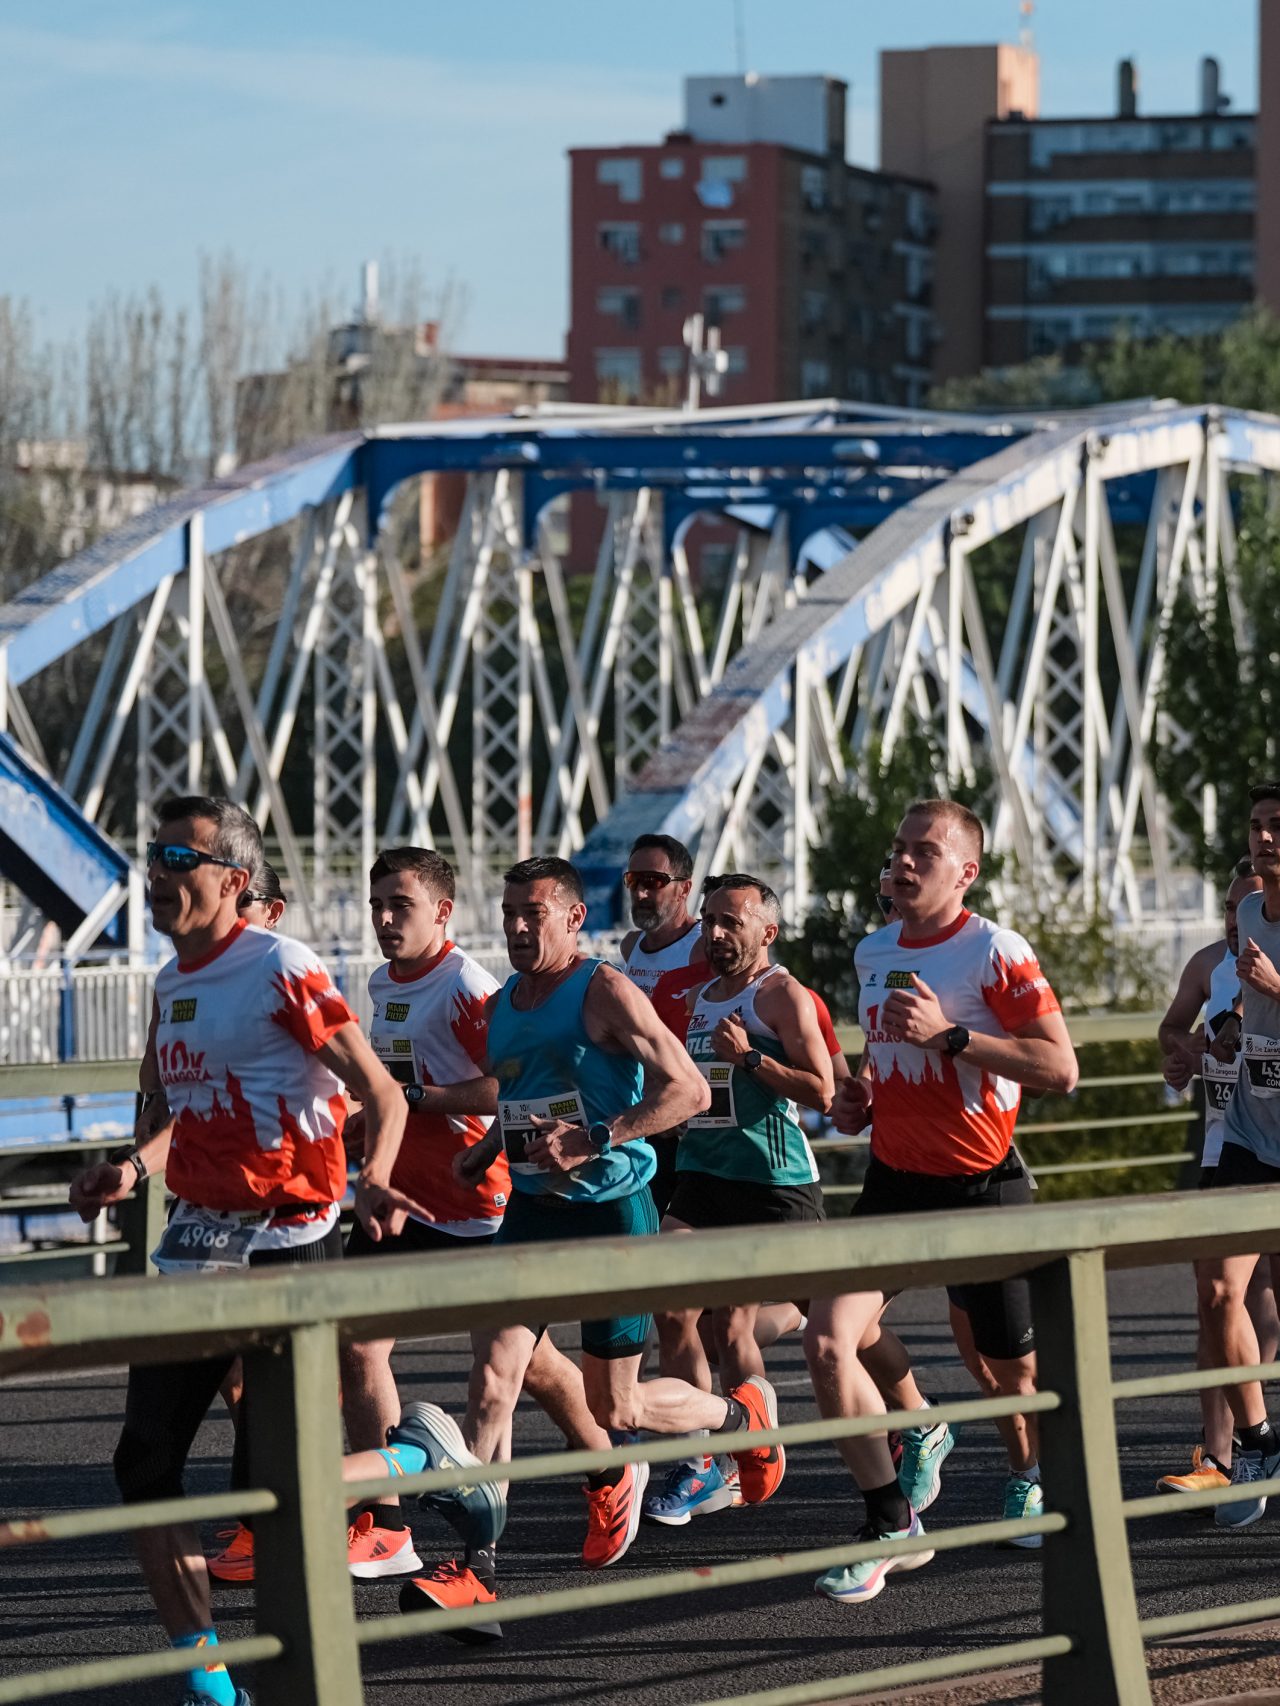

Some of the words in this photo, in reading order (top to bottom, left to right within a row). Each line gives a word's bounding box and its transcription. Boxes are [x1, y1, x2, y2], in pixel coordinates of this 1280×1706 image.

[388, 1003, 409, 1012] MANN
[386, 1011, 407, 1021] FILTER
[866, 1031, 901, 1043] ZARA
[550, 1099, 576, 1110] MANN
[551, 1106, 577, 1115] FILTER
[519, 1112, 547, 1121] Zaroza
[178, 1225, 232, 1249] 4968
